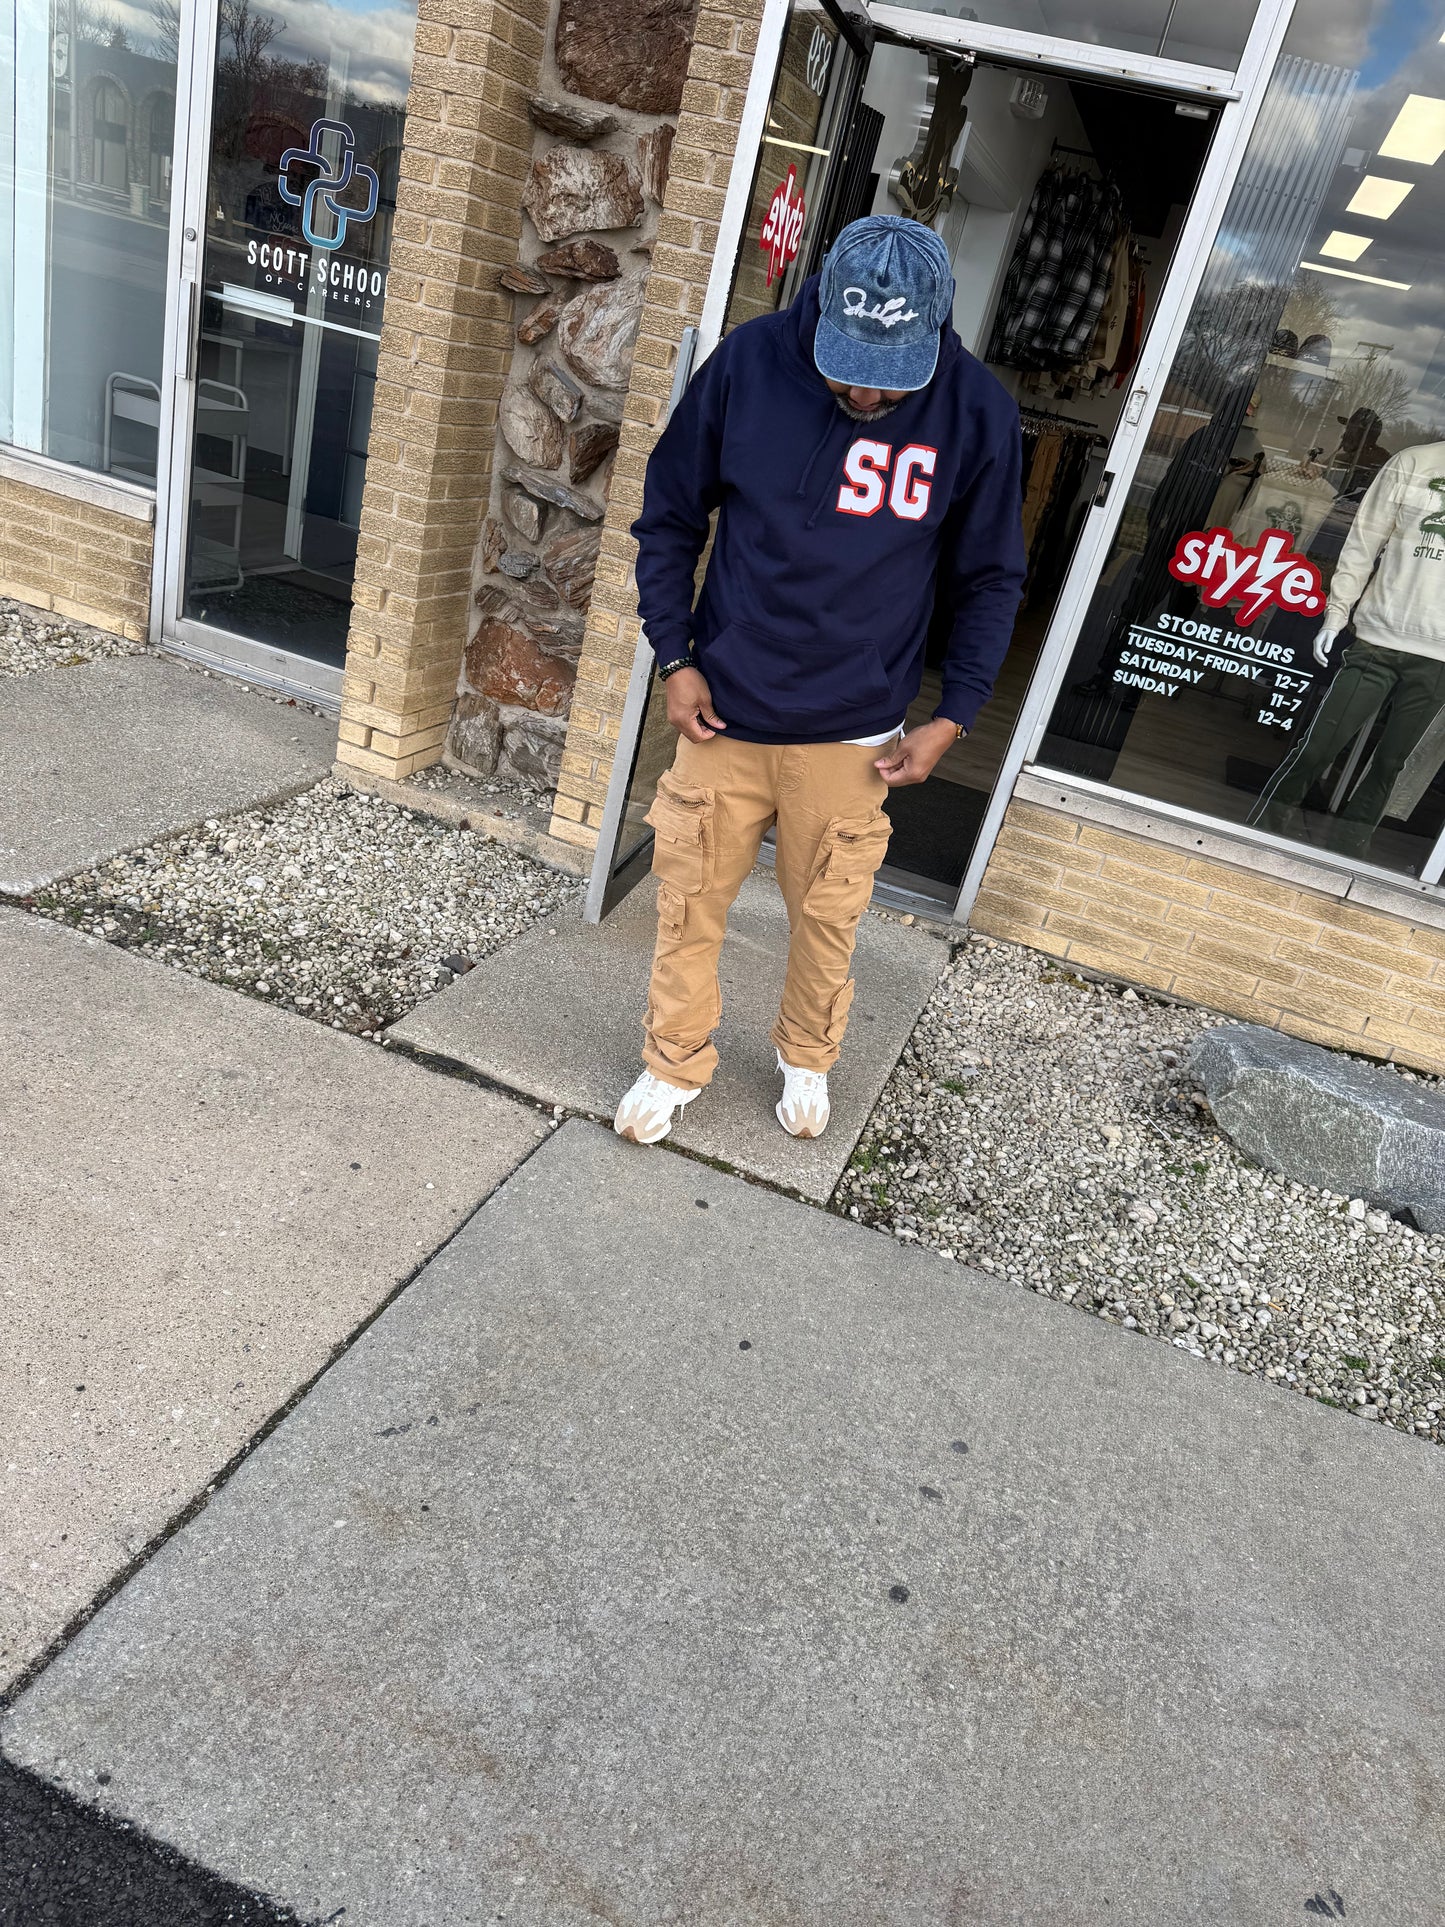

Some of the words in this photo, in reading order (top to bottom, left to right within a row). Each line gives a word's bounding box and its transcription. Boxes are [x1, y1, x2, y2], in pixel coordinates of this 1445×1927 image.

[247, 240, 309, 278] SCOTT
[317, 258, 389, 299] SCHOO
[265, 274, 283, 285] OF
[297, 282, 371, 308] CAREERS
[836, 437, 938, 521] SG
[1413, 546, 1444, 561] STYLE
[1127, 632, 1263, 680] TUESDAY-FRIDAY
[1274, 673, 1310, 694] 12-7
[1157, 613, 1223, 644] STORE
[1223, 631, 1295, 664] HOURS
[1113, 669, 1179, 697] SUNDAY
[1257, 709, 1293, 731] 12-4
[1119, 650, 1205, 684] SATURDAY
[1270, 692, 1302, 712] 11-7
